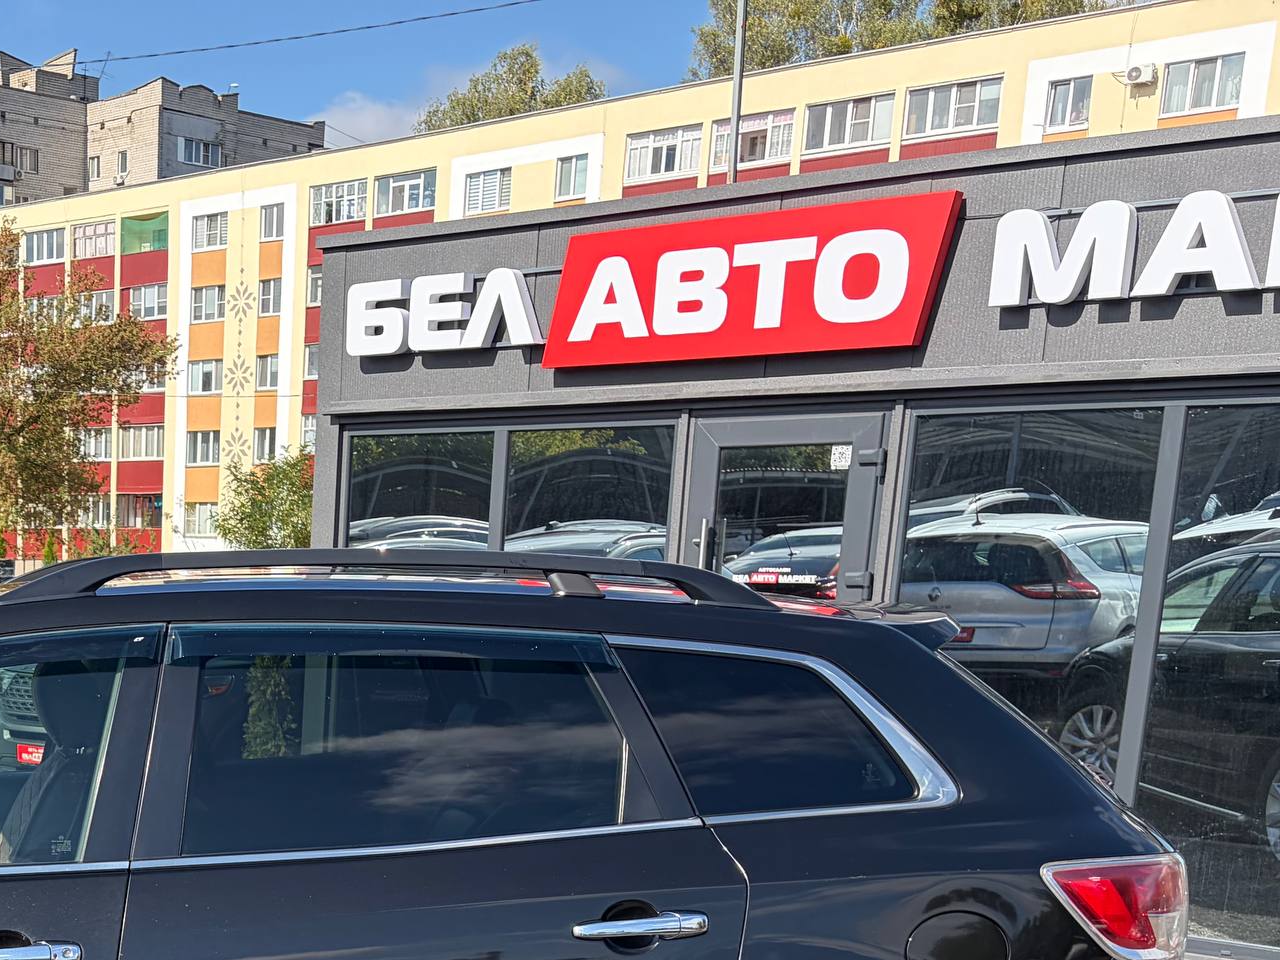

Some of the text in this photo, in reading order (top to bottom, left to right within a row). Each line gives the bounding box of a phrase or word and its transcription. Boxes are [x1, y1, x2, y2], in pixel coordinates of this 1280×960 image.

[345, 189, 1280, 357] БЕЛ АВТО МА
[778, 574, 817, 584] МАРКЕТ
